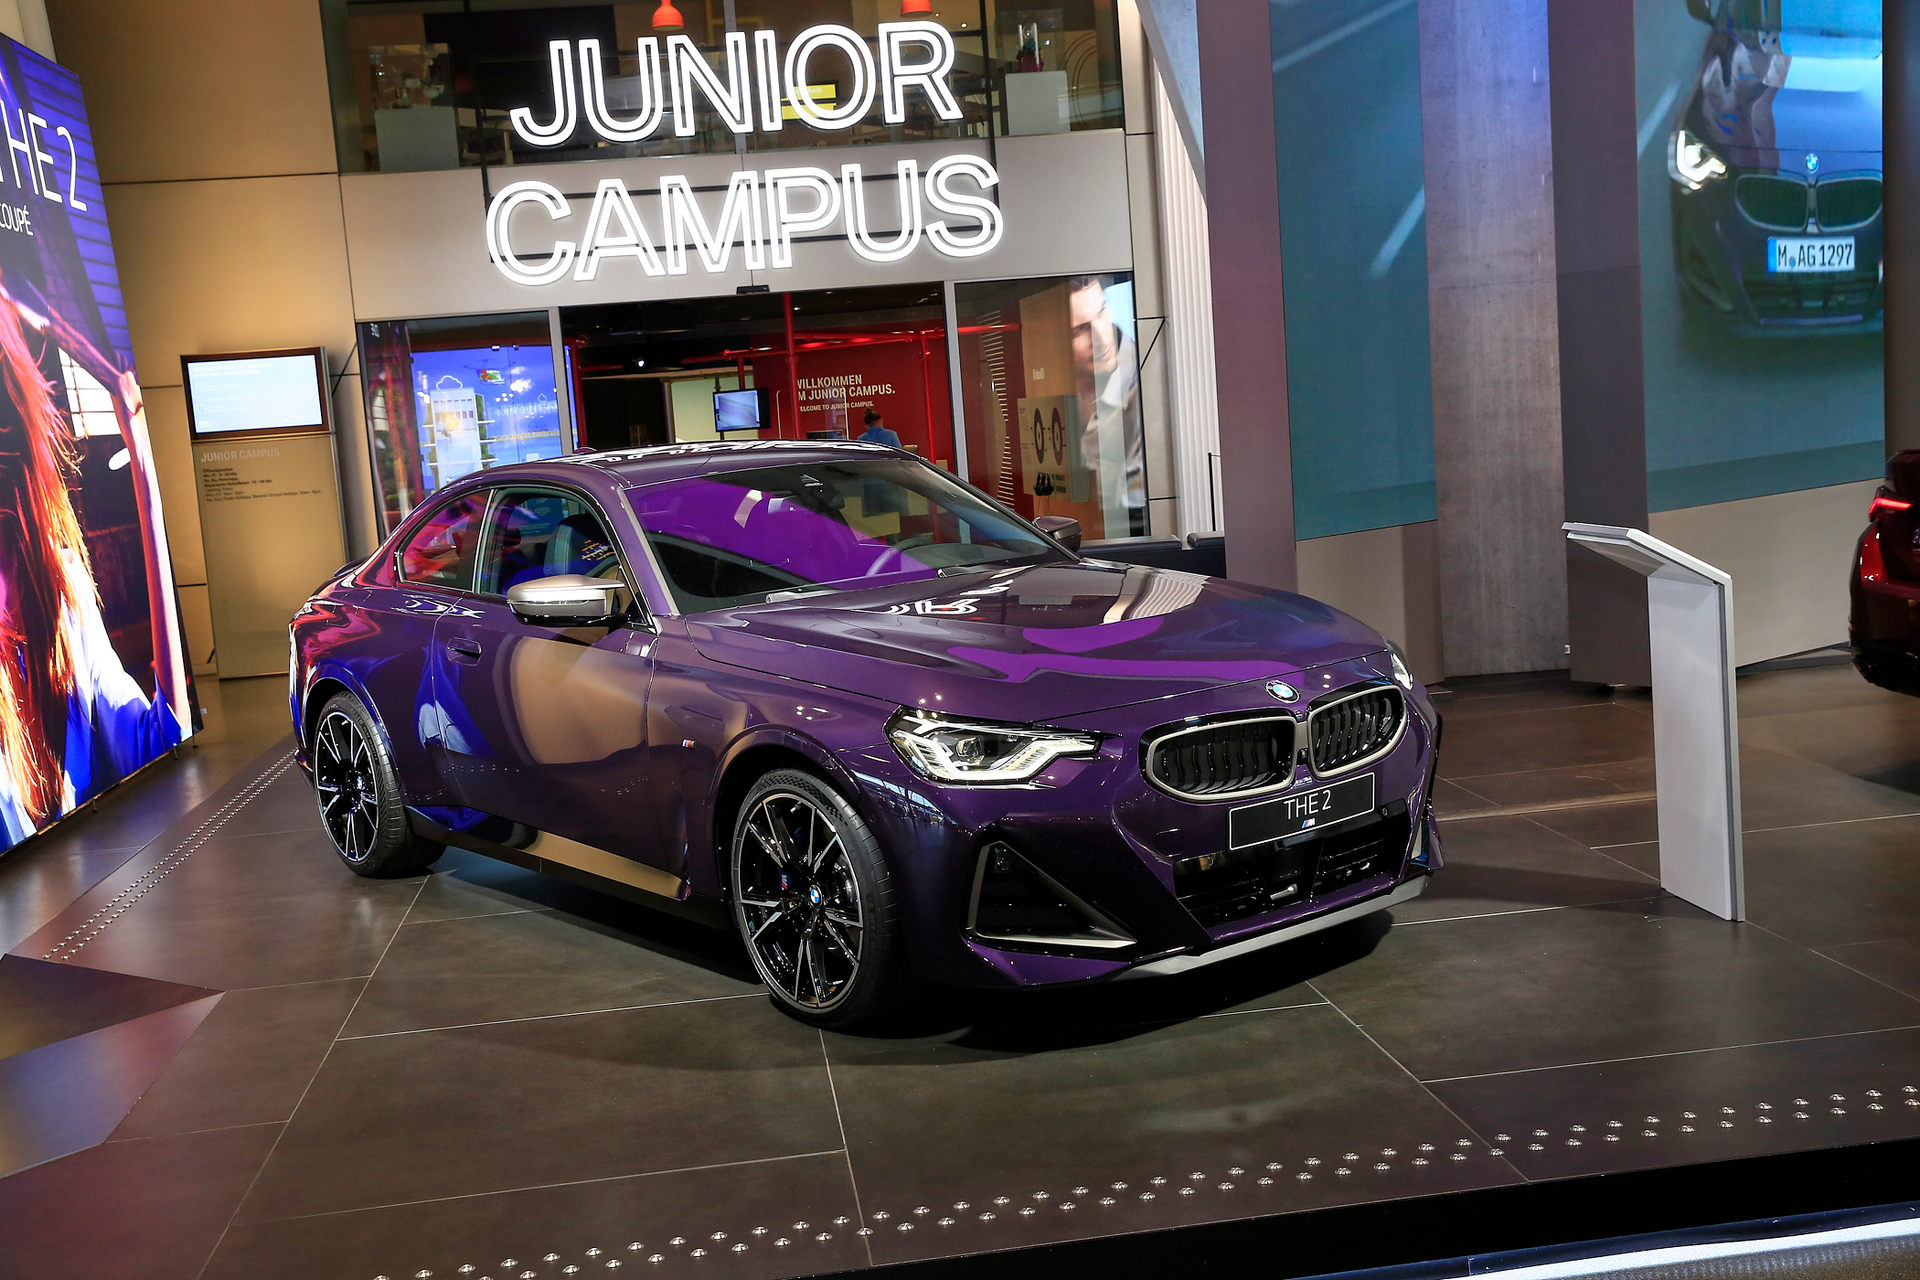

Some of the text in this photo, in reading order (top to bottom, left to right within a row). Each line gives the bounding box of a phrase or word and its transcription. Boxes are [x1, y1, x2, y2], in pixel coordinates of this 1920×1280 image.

[510, 20, 964, 147] JUNIOR
[0, 98, 88, 212] HE 2
[485, 154, 1004, 287] CAMPUS
[1777, 243, 1853, 267] M AG 1297
[808, 386, 847, 401] JUNIOR
[849, 383, 896, 397] CAMPUS.
[800, 404, 822, 412] ELCOME
[201, 447, 281, 463] JUNIOR CAMPUS
[1283, 789, 1332, 820] THE 2
